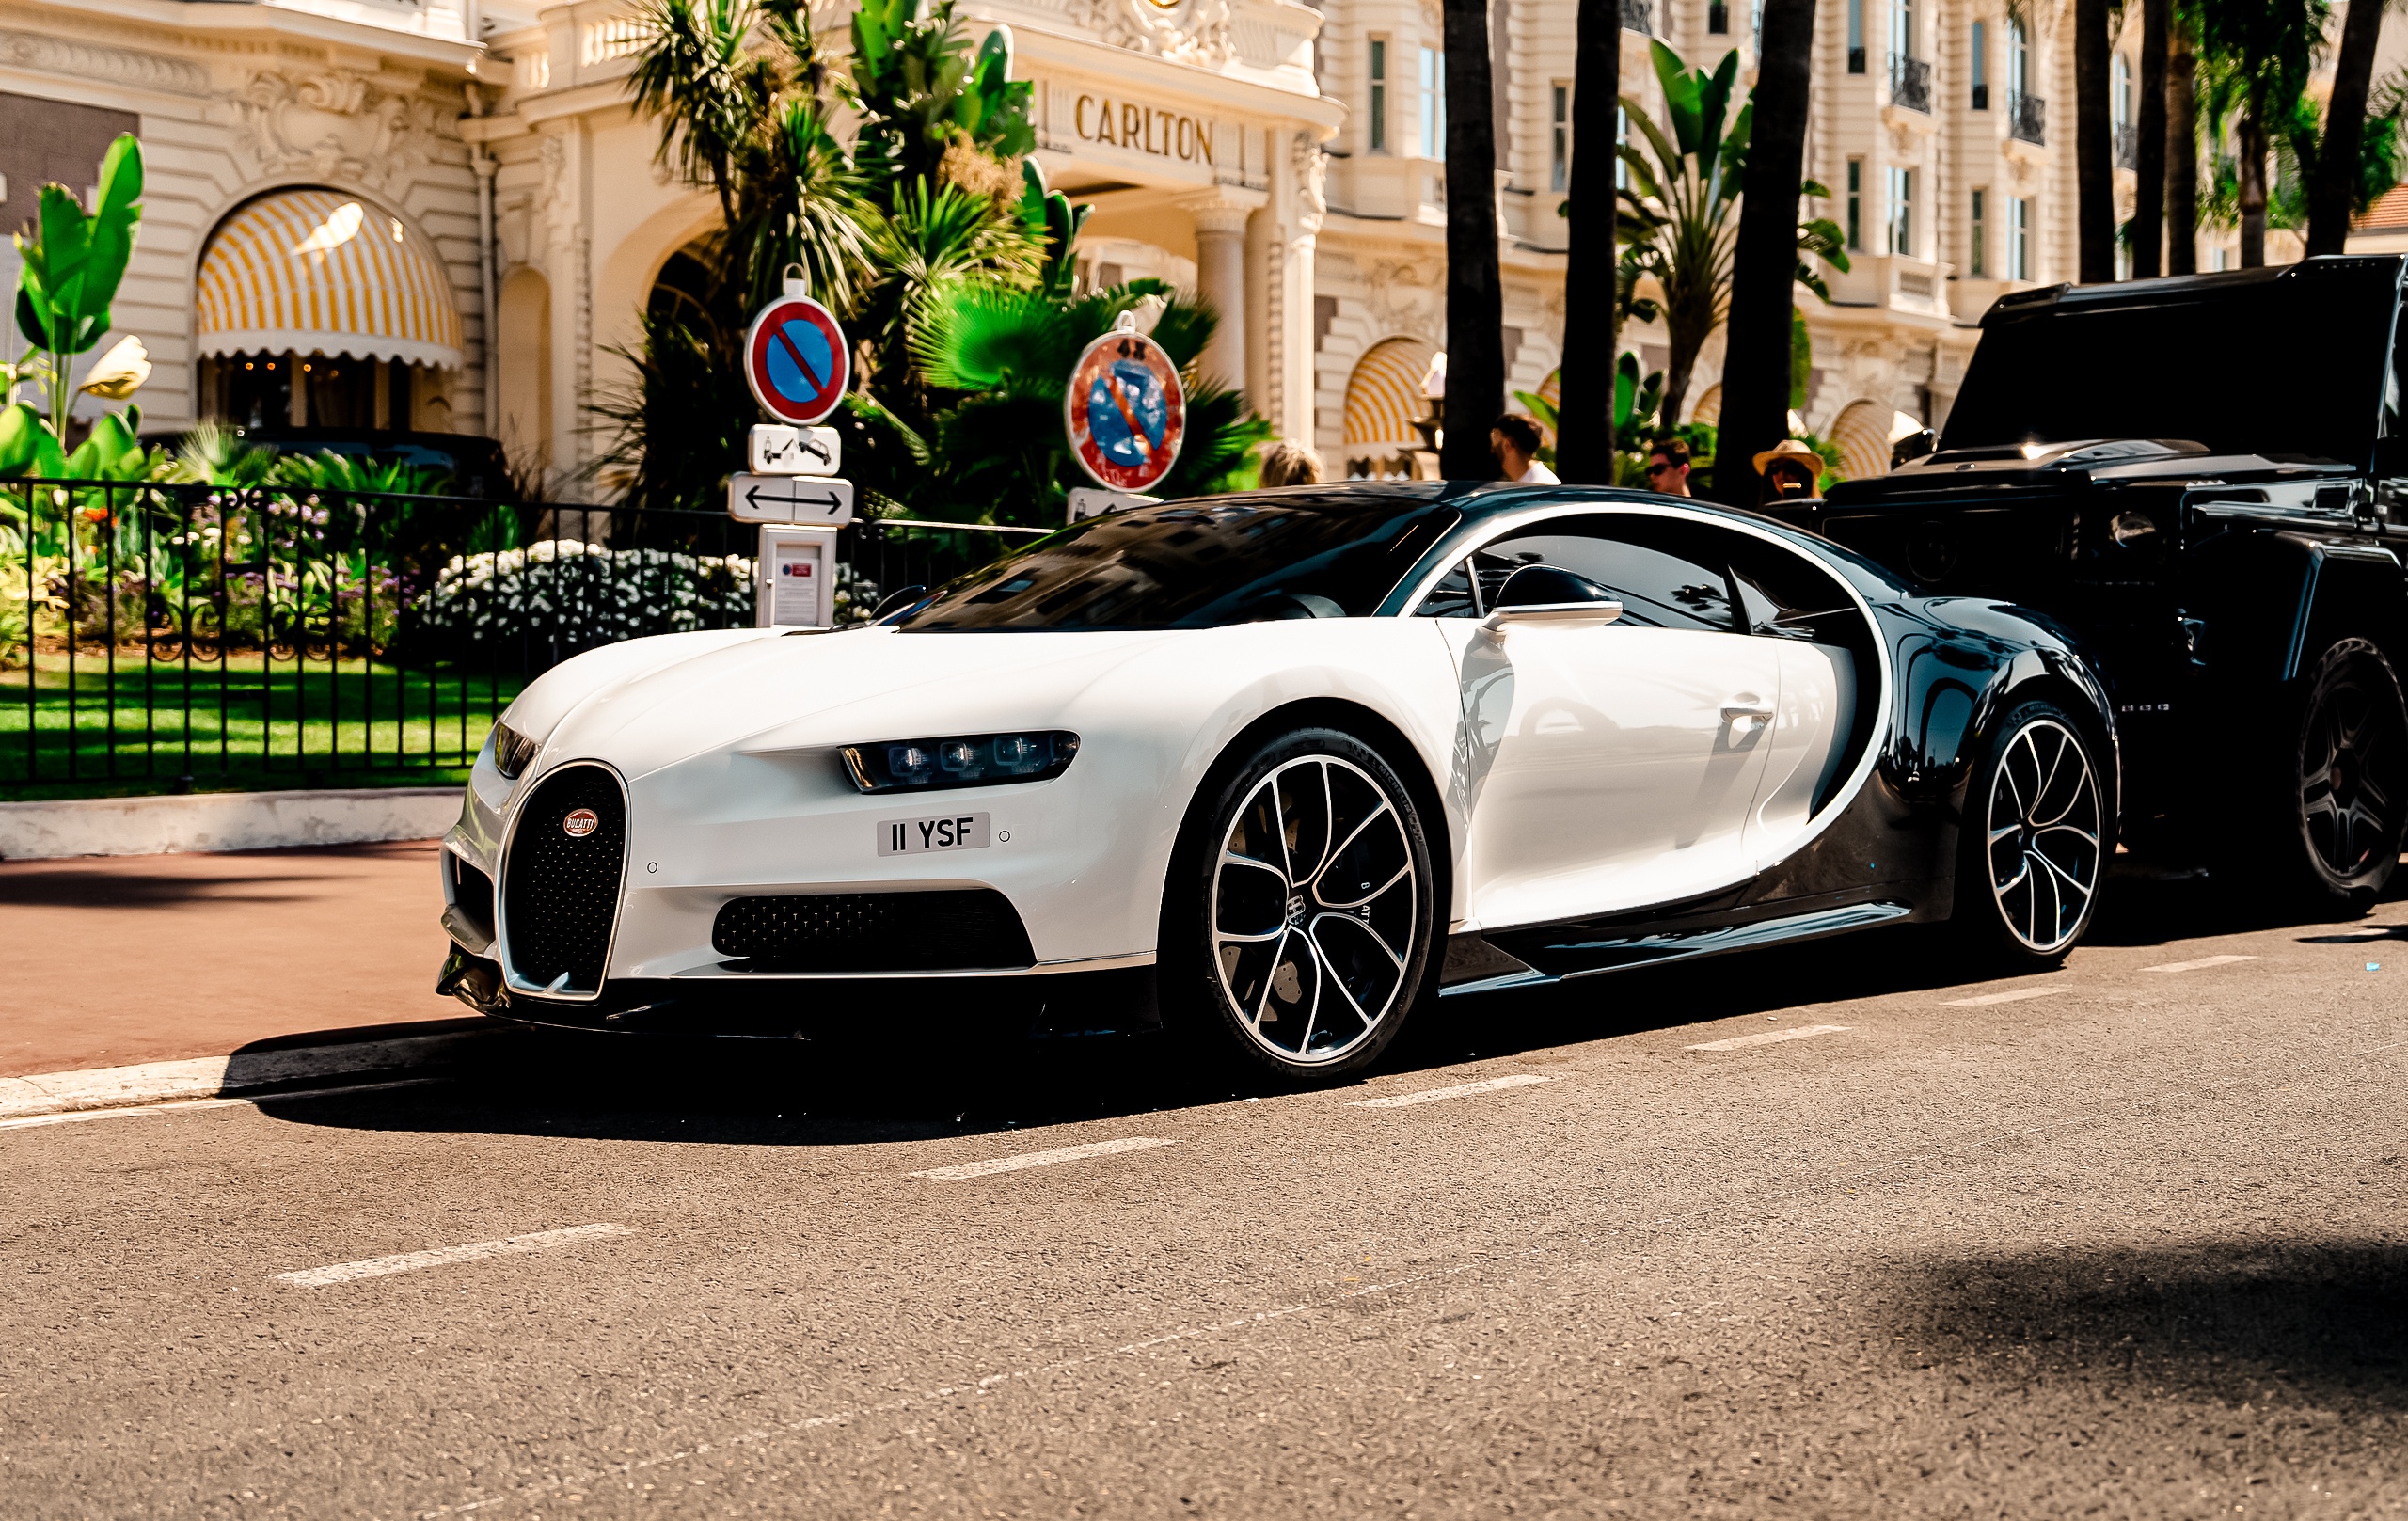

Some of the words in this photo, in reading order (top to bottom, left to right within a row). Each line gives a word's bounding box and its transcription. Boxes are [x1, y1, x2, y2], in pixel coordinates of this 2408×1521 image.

[1075, 94, 1212, 165] CARLTON
[1377, 764, 1414, 815] MICHELIN
[566, 817, 594, 829] BUGATTI
[918, 816, 974, 848] YSF
